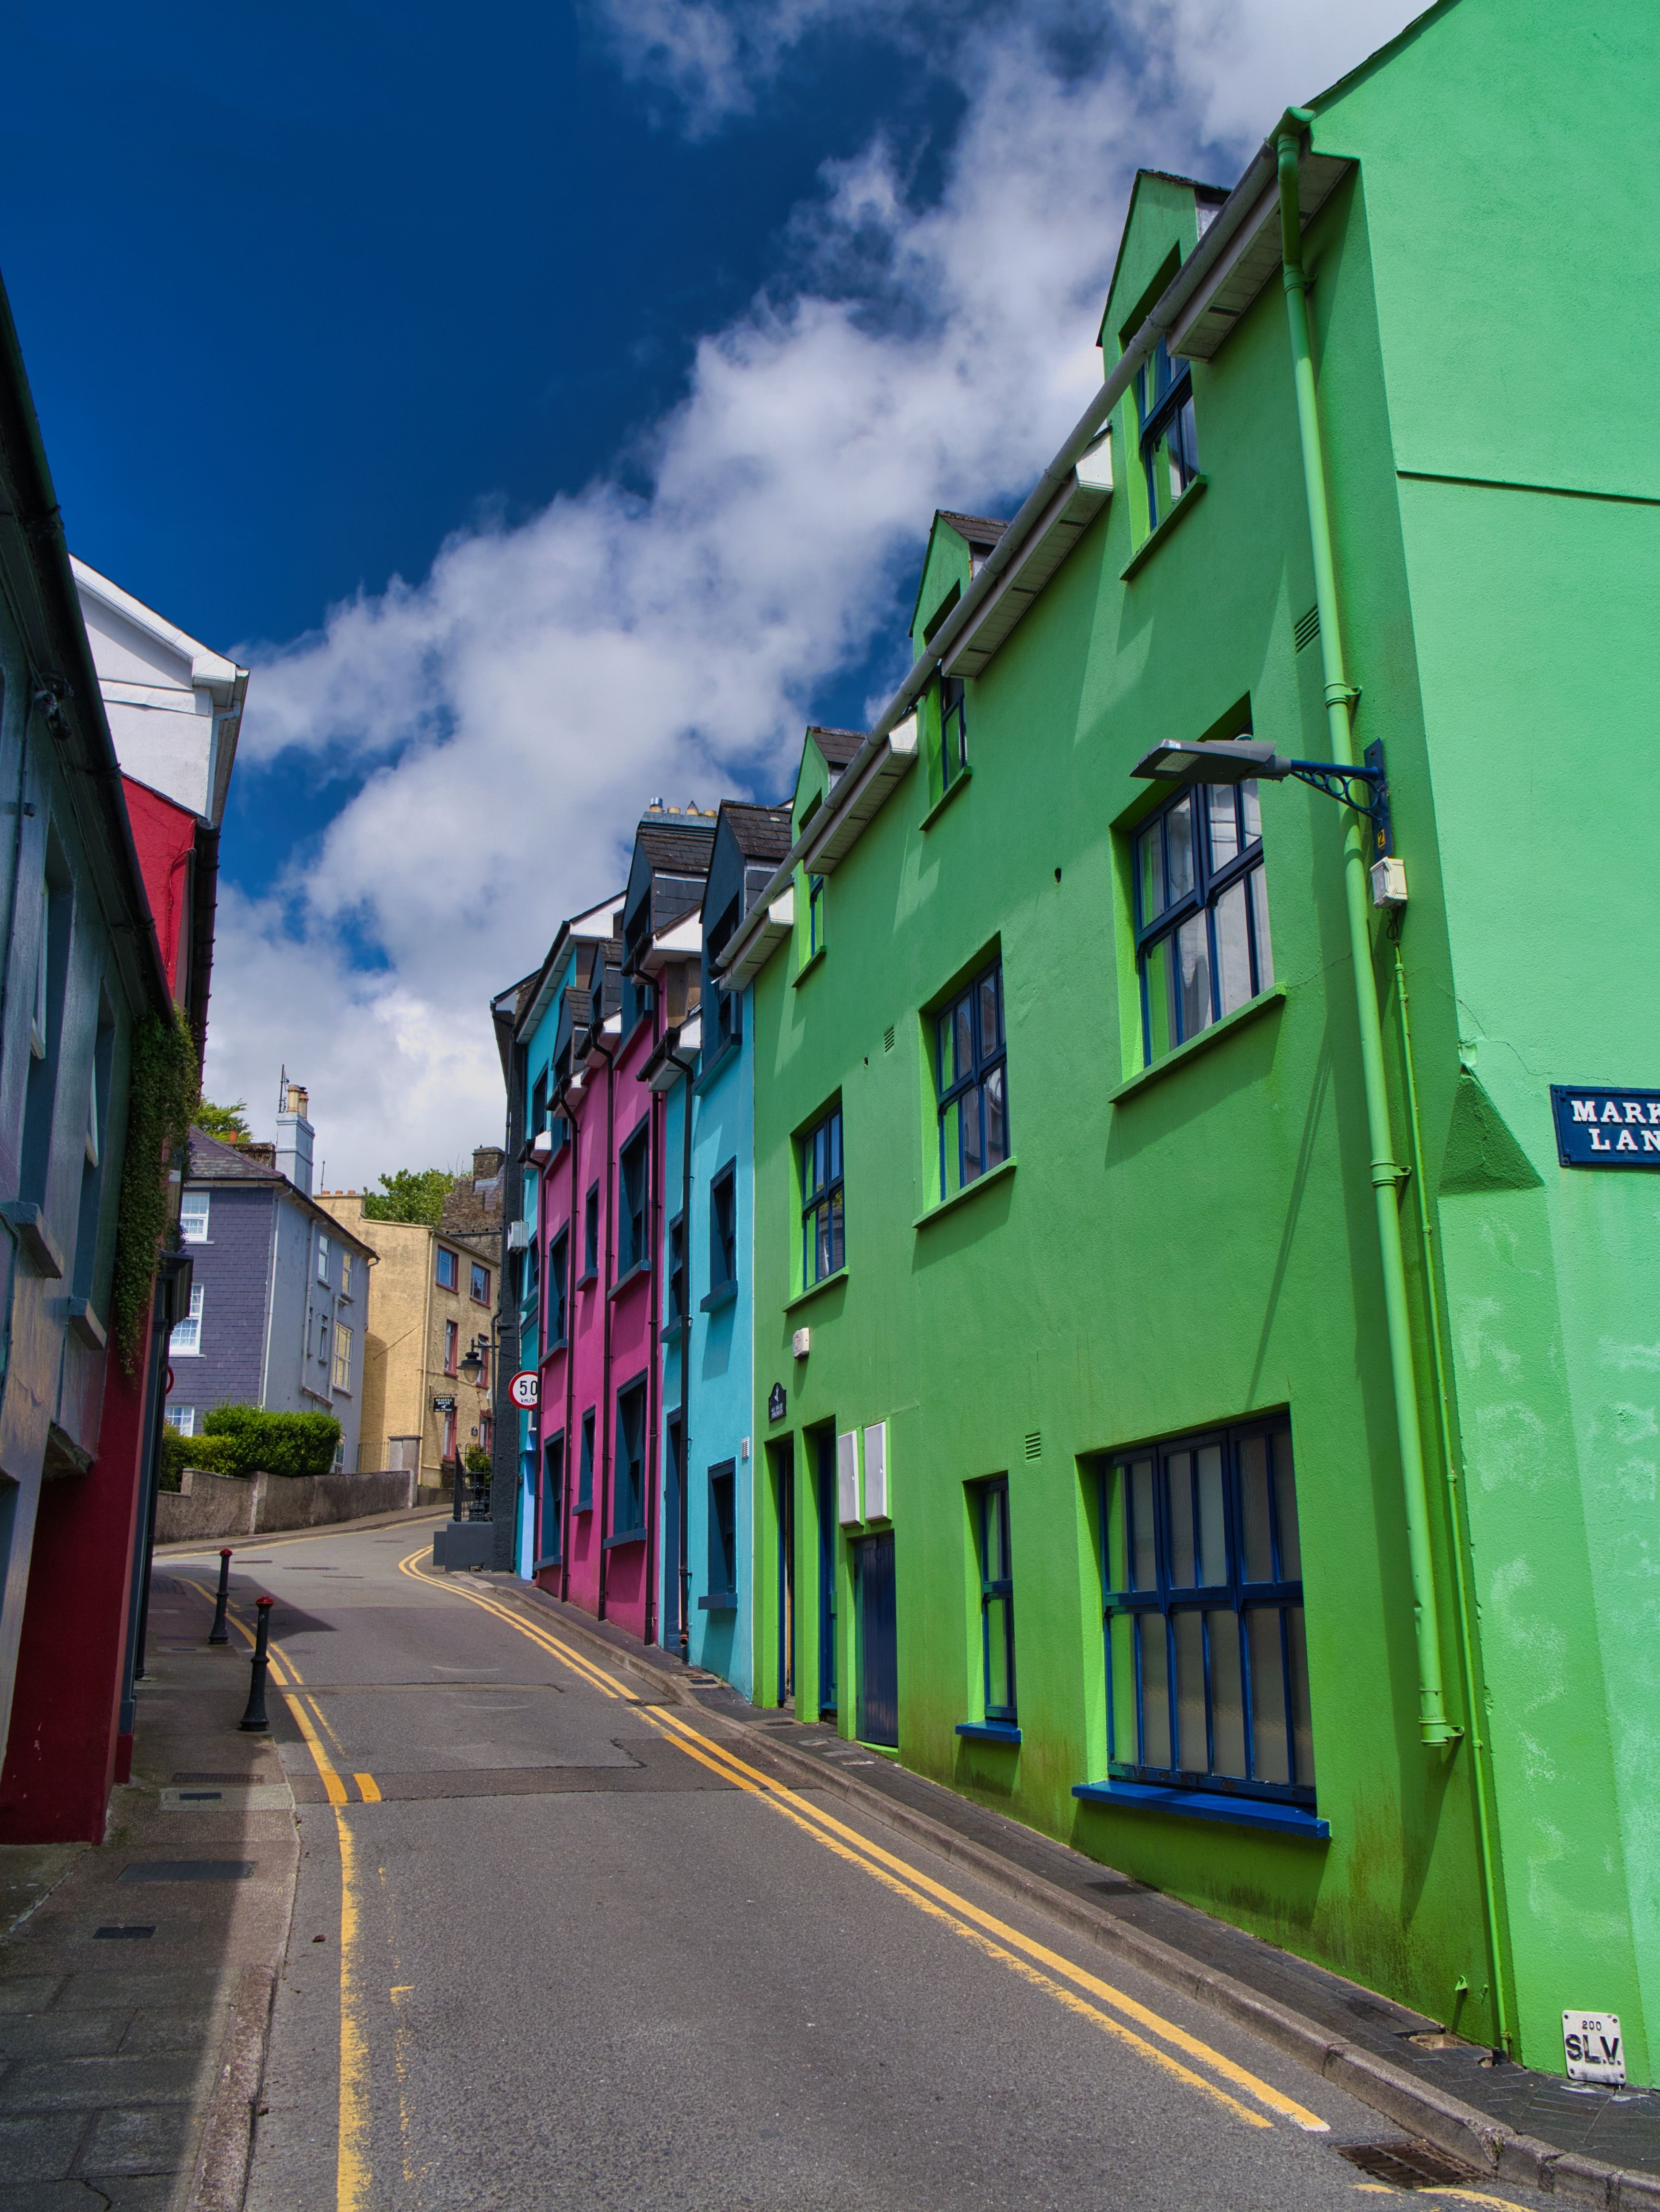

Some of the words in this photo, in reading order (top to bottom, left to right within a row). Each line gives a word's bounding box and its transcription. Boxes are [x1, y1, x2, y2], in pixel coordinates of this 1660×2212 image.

[1378, 831, 1384, 845] 2
[1588, 1129, 1660, 1152] LAN
[520, 1381, 537, 1396] 50
[1582, 2020, 1602, 2031] 200
